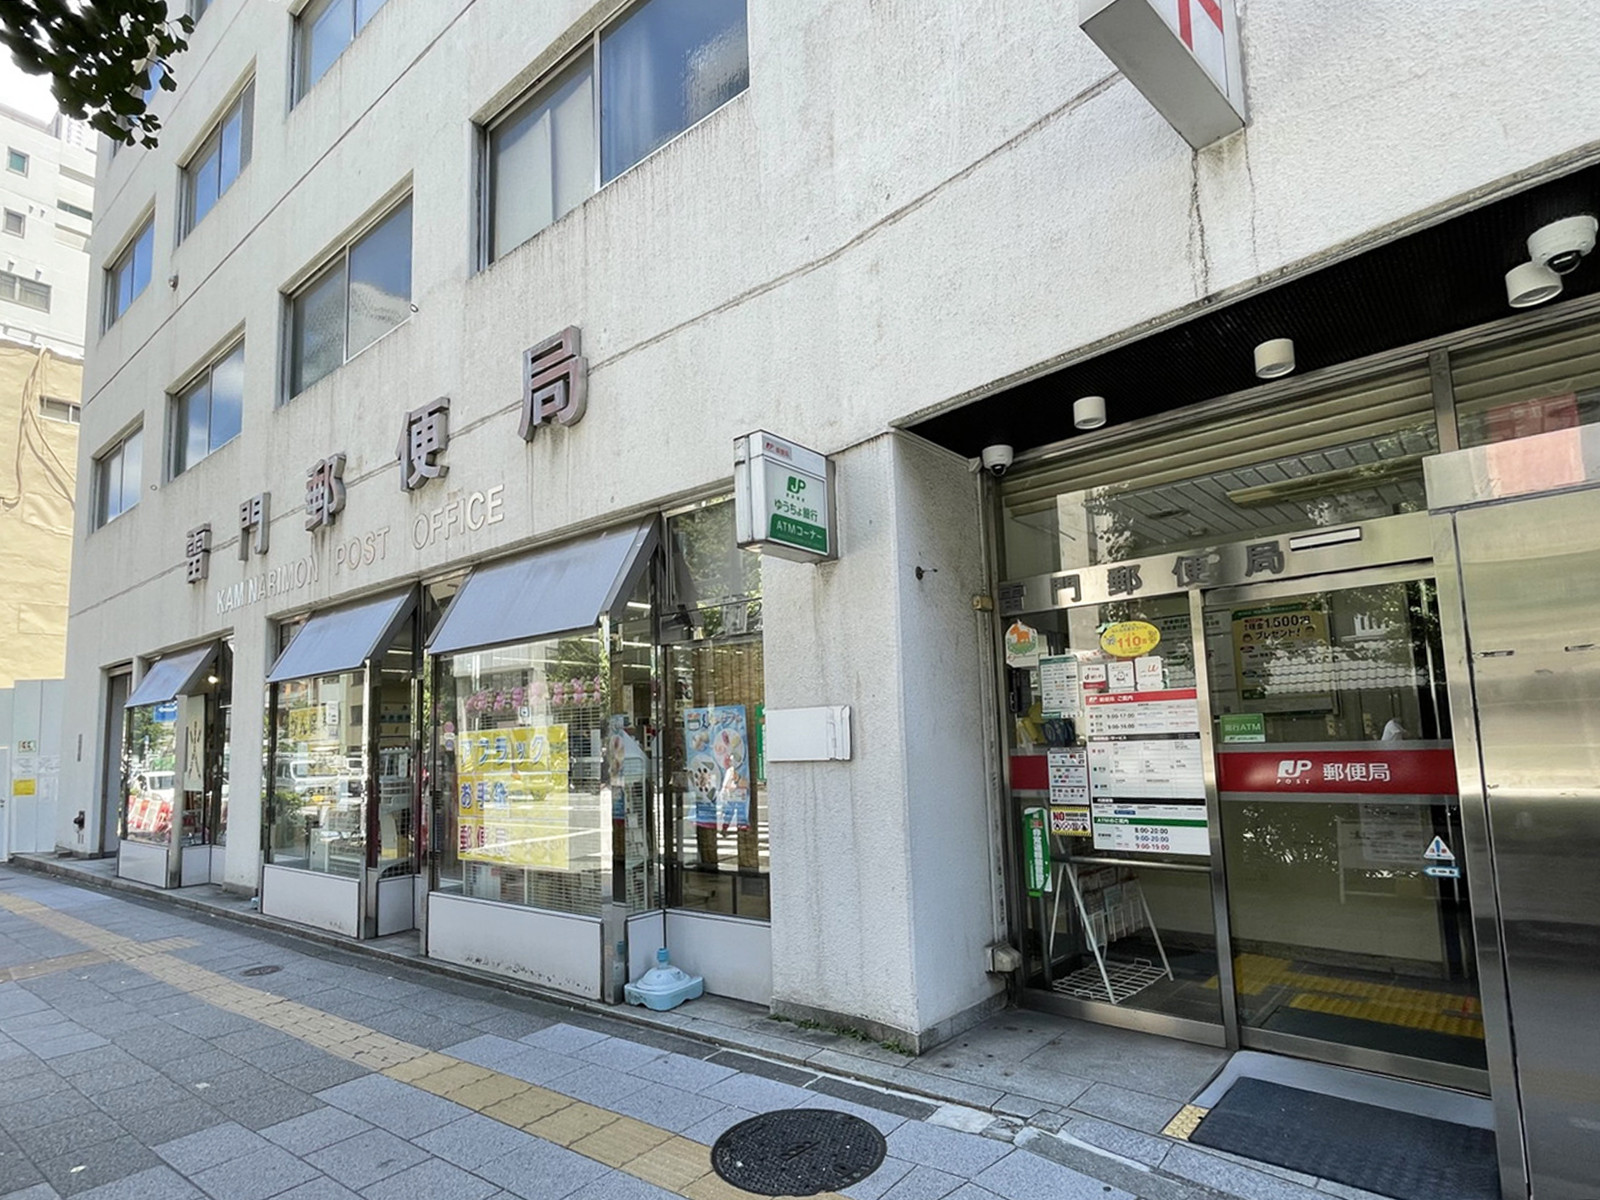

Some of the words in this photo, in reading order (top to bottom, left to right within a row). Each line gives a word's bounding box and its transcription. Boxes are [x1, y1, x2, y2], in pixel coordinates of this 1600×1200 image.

[186, 325, 589, 585] 雷門郵便局
[774, 499, 818, 522] ゆうちょ銀行
[775, 520, 823, 540] ATMコーナー
[216, 553, 319, 615] KAMINARIMON
[335, 527, 390, 578] POST
[411, 485, 506, 552] OFFICE
[1278, 760, 1312, 778] JP
[1322, 763, 1391, 782] 郵便局
[1053, 812, 1065, 822] NO
